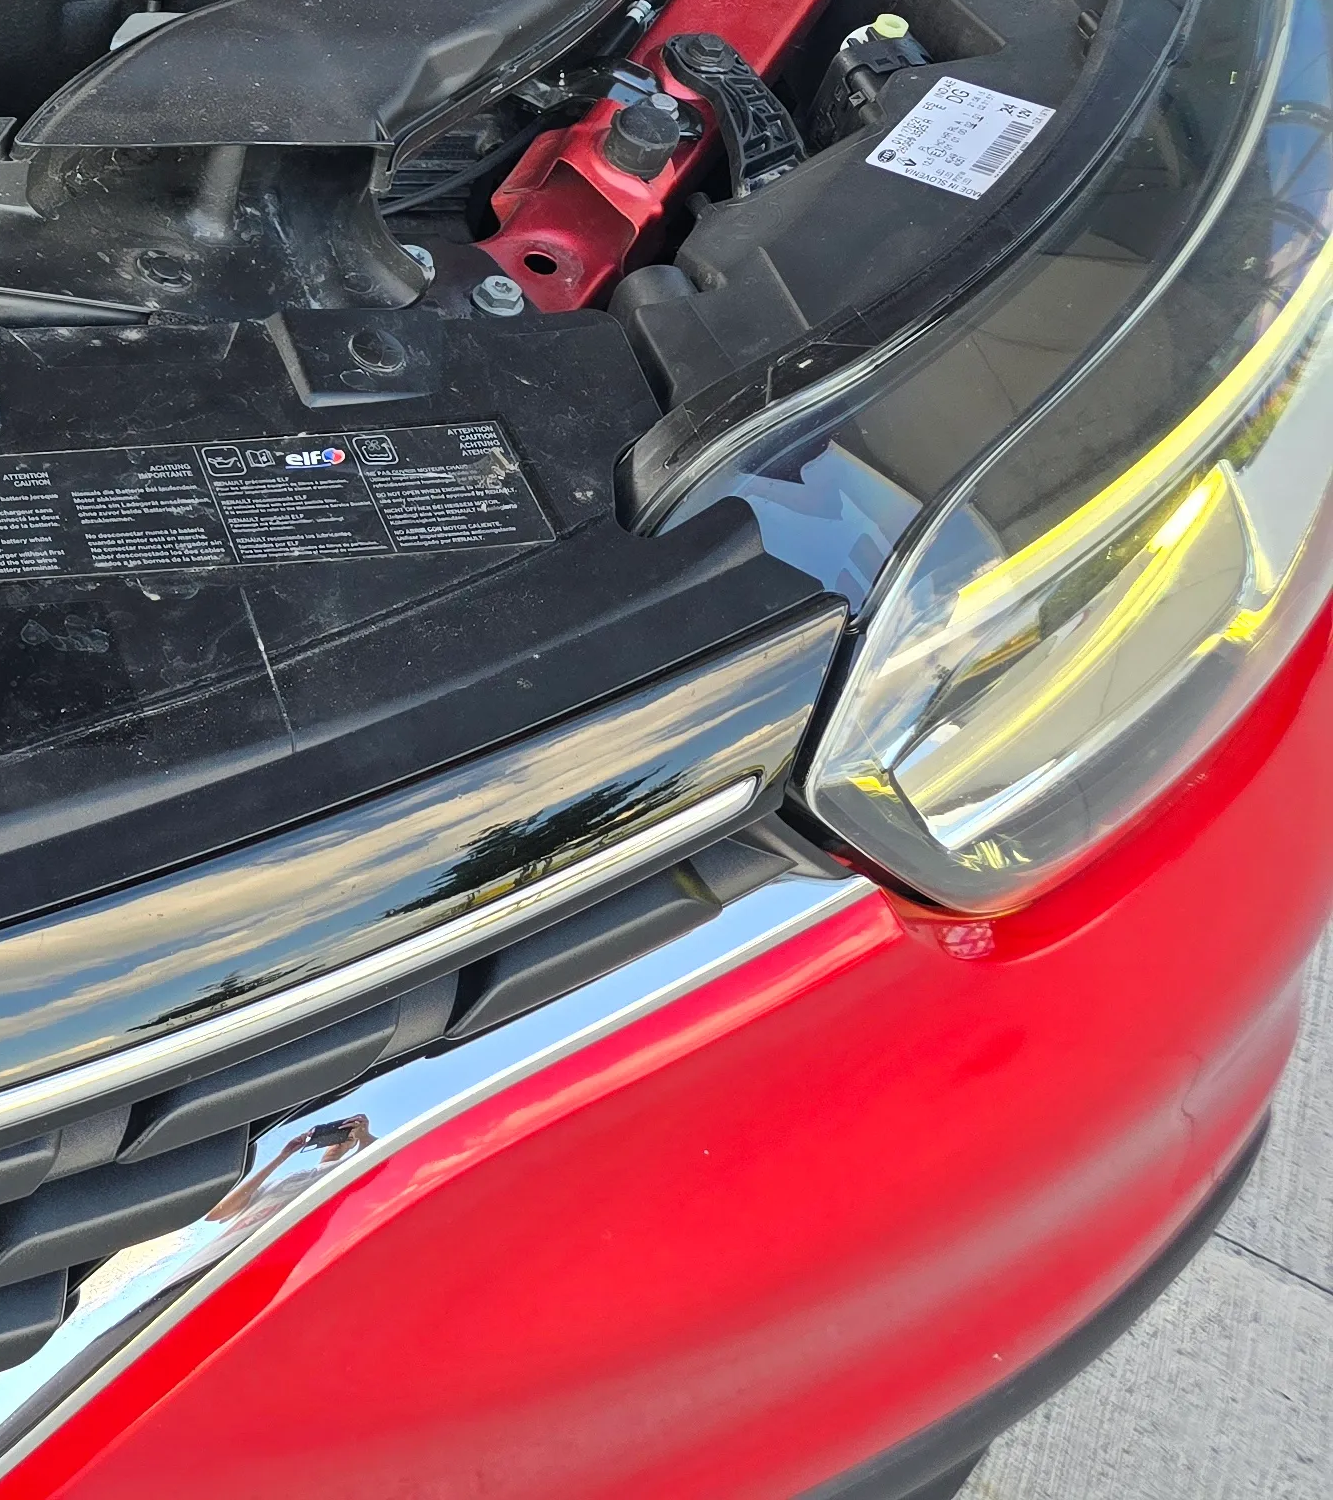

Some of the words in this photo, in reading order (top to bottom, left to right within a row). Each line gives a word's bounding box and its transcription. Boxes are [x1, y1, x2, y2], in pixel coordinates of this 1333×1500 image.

[944, 87, 971, 104] DG
[903, 167, 948, 186] SLOVENIA
[446, 426, 493, 435] ATTENTION
[459, 432, 497, 440] CAUTION
[457, 440, 500, 448] ACHTUNG
[285, 451, 320, 465] elf
[148, 463, 190, 471] ACHTUNG
[2, 472, 48, 480] ATTENTION
[138, 470, 193, 479] IMPORTANTE
[13, 479, 51, 487] CAUTION
